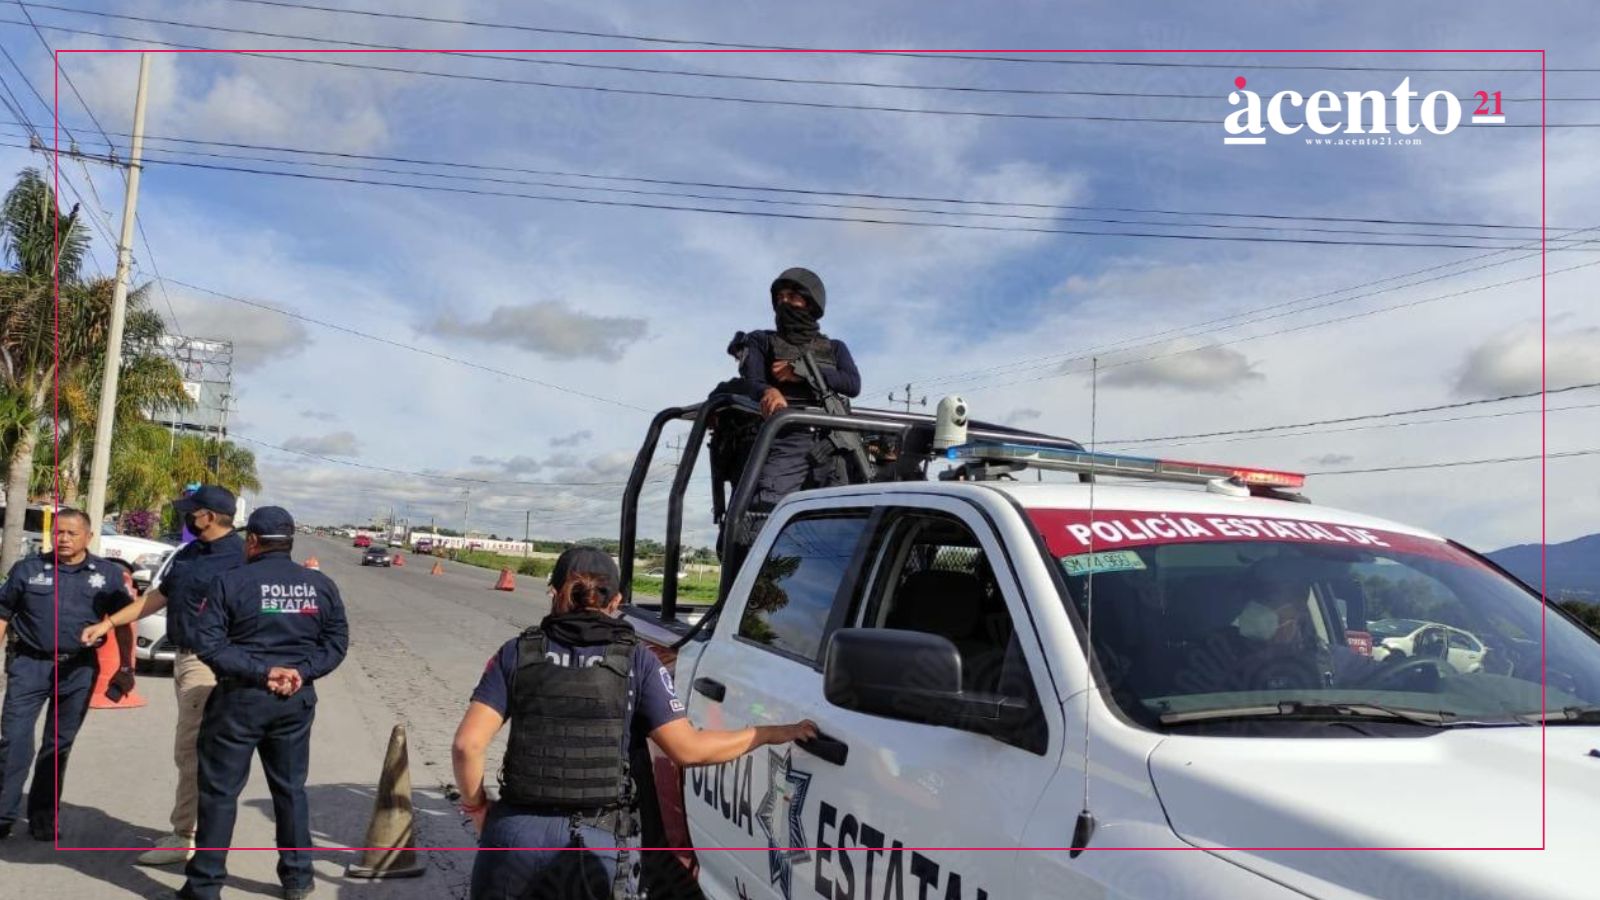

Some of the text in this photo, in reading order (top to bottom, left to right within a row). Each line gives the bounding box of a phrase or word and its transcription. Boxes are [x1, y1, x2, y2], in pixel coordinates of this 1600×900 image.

[1066, 514, 1391, 548] POLICÍA ESTATAL DE
[261, 582, 317, 597] POLICÍA
[262, 598, 318, 609] ESTATAL
[815, 801, 989, 900] ESTAT
